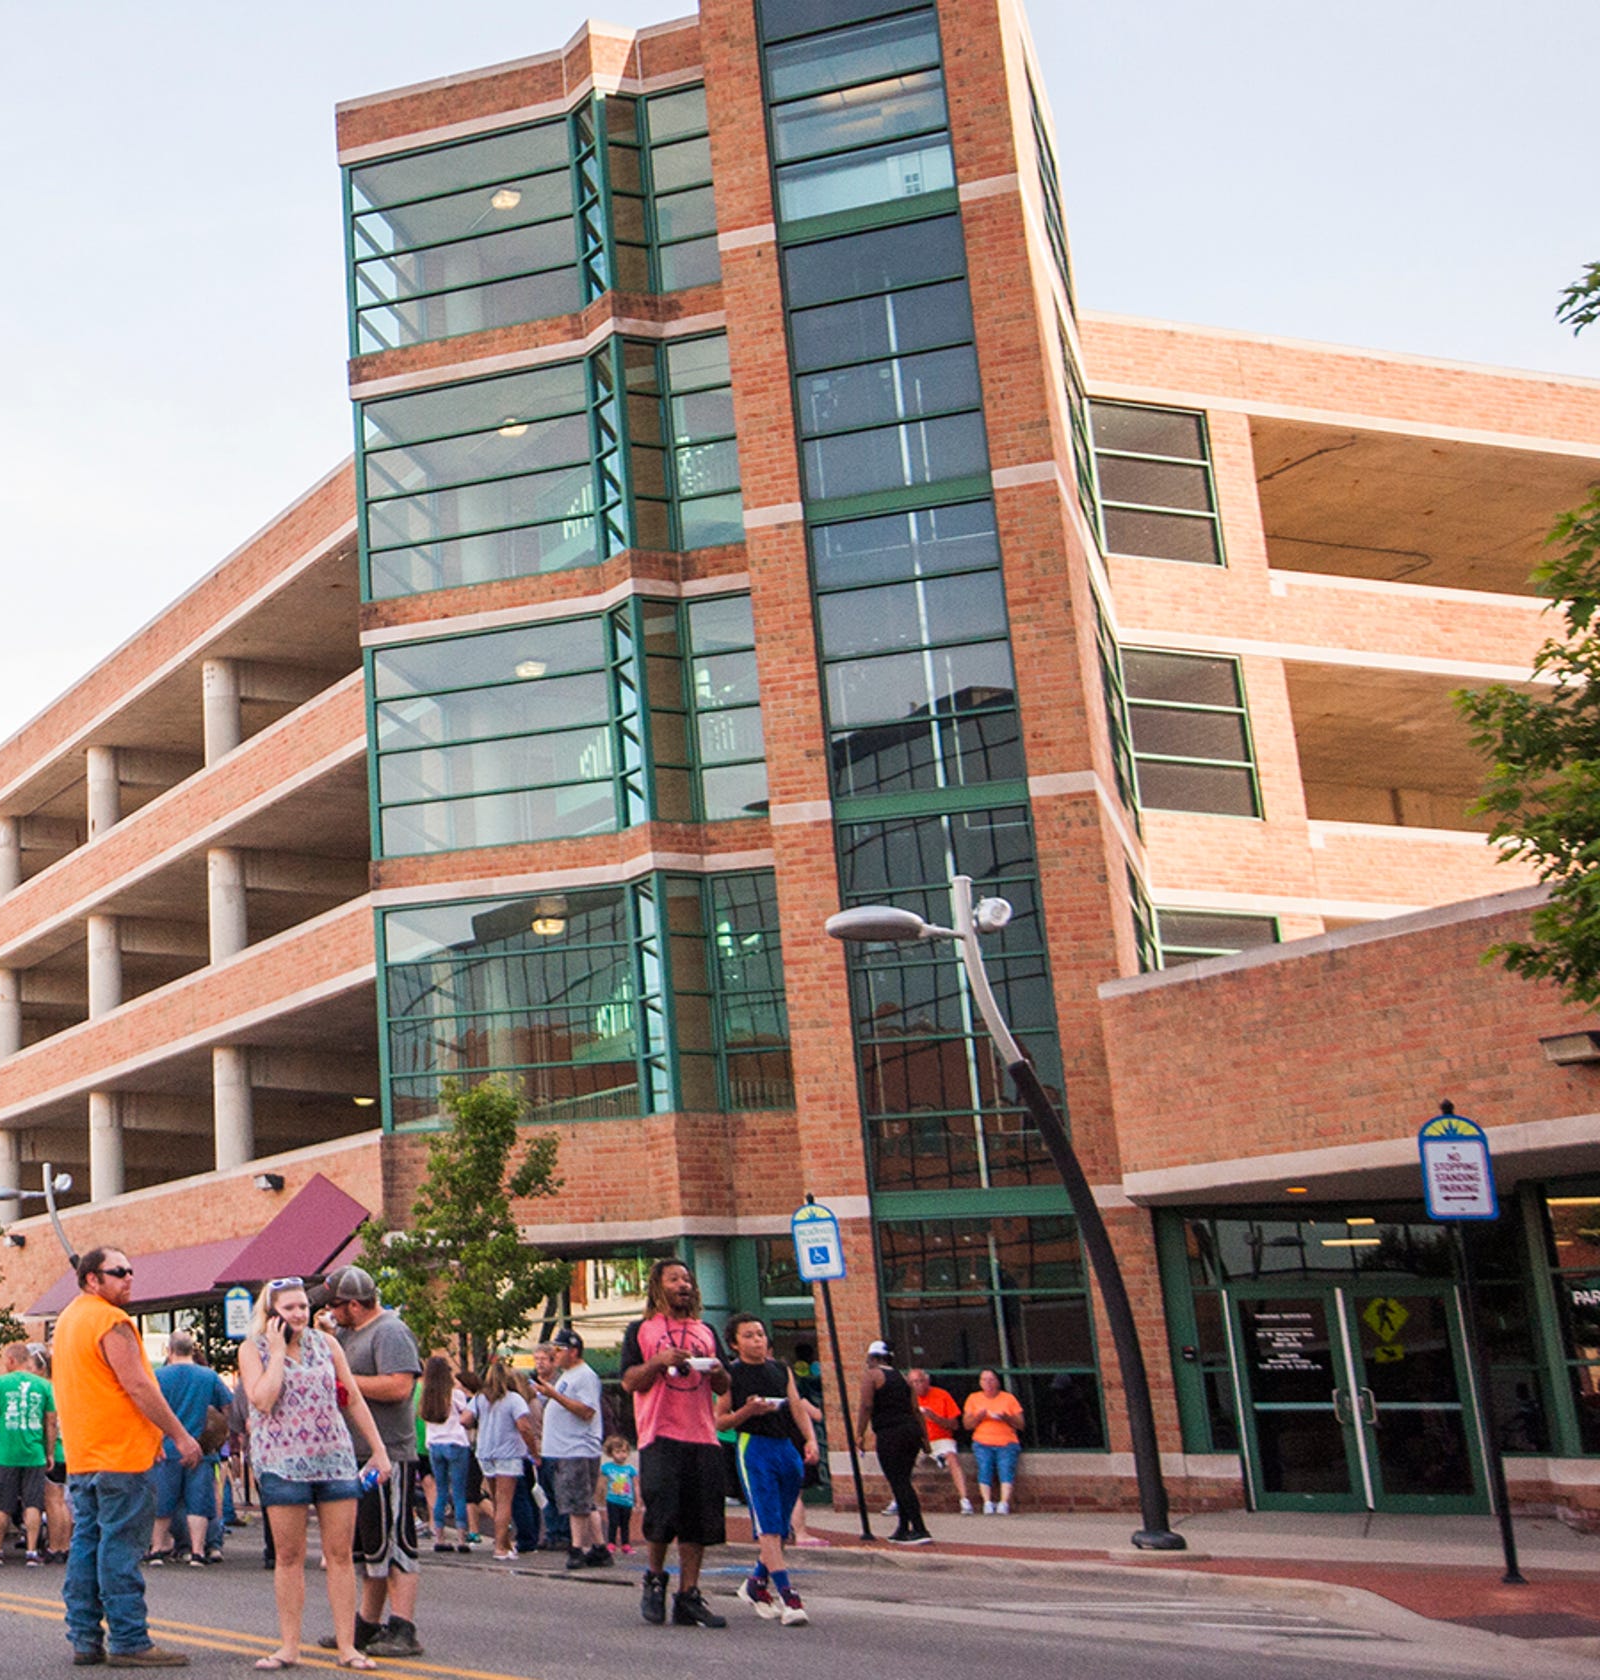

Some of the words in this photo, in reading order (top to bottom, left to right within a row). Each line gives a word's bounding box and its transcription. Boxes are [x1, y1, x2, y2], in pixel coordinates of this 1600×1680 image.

[1446, 1152, 1461, 1162] NO
[1433, 1162, 1479, 1172] STOPPING
[1434, 1173, 1481, 1183] STANDING
[1438, 1184, 1480, 1193] PARKING
